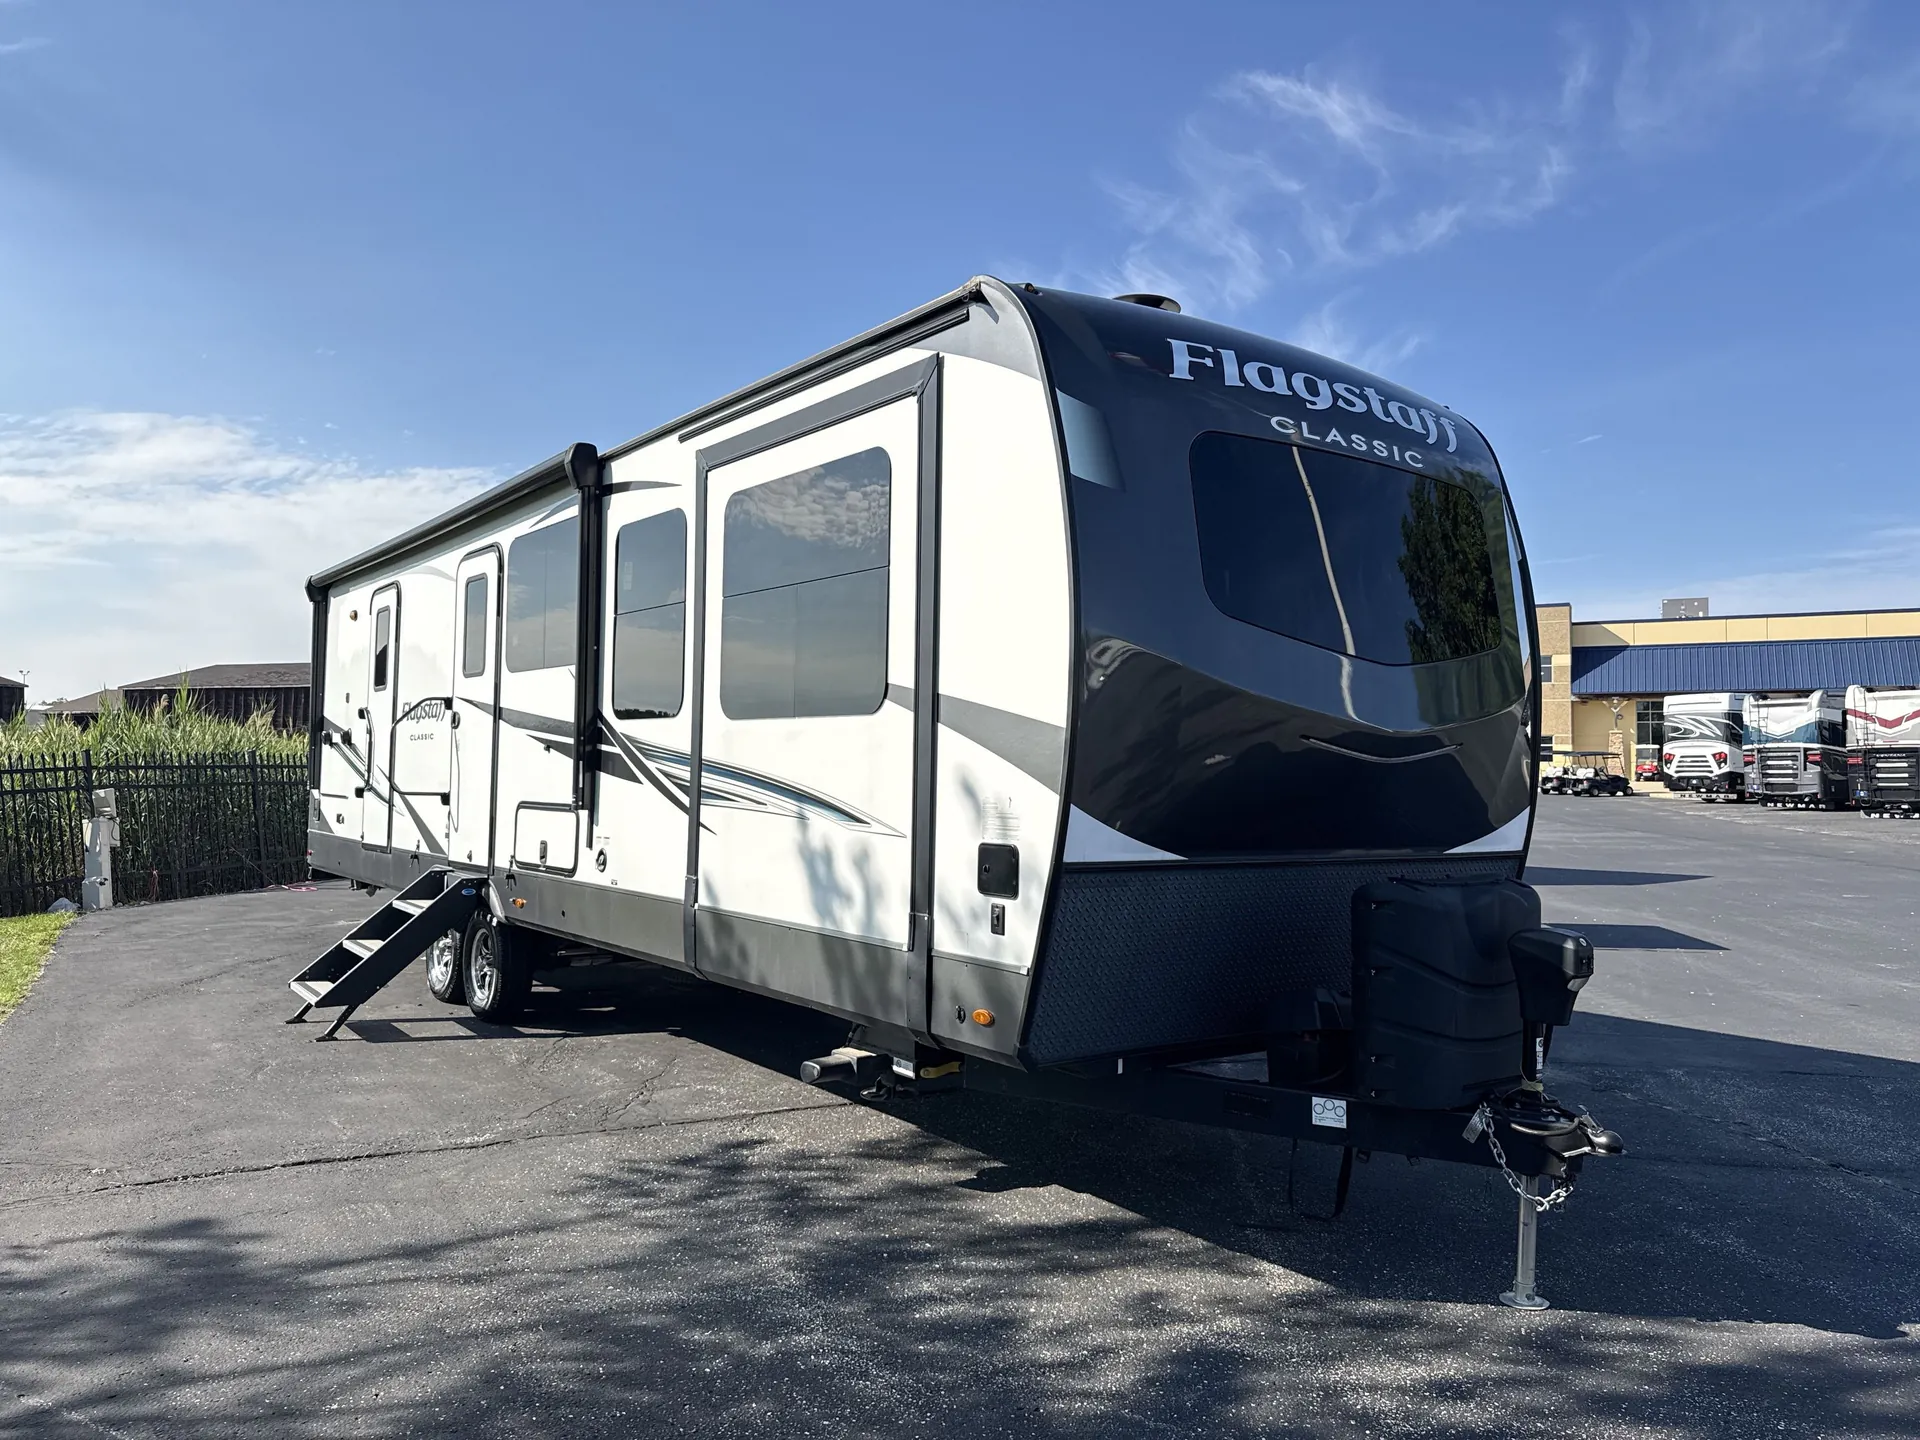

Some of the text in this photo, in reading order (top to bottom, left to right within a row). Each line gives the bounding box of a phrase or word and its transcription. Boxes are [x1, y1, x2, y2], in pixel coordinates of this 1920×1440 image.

[1166, 338, 1457, 453] Flagstaff
[1270, 416, 1424, 468] CLASSIC
[410, 733, 434, 741] CLASSIC
